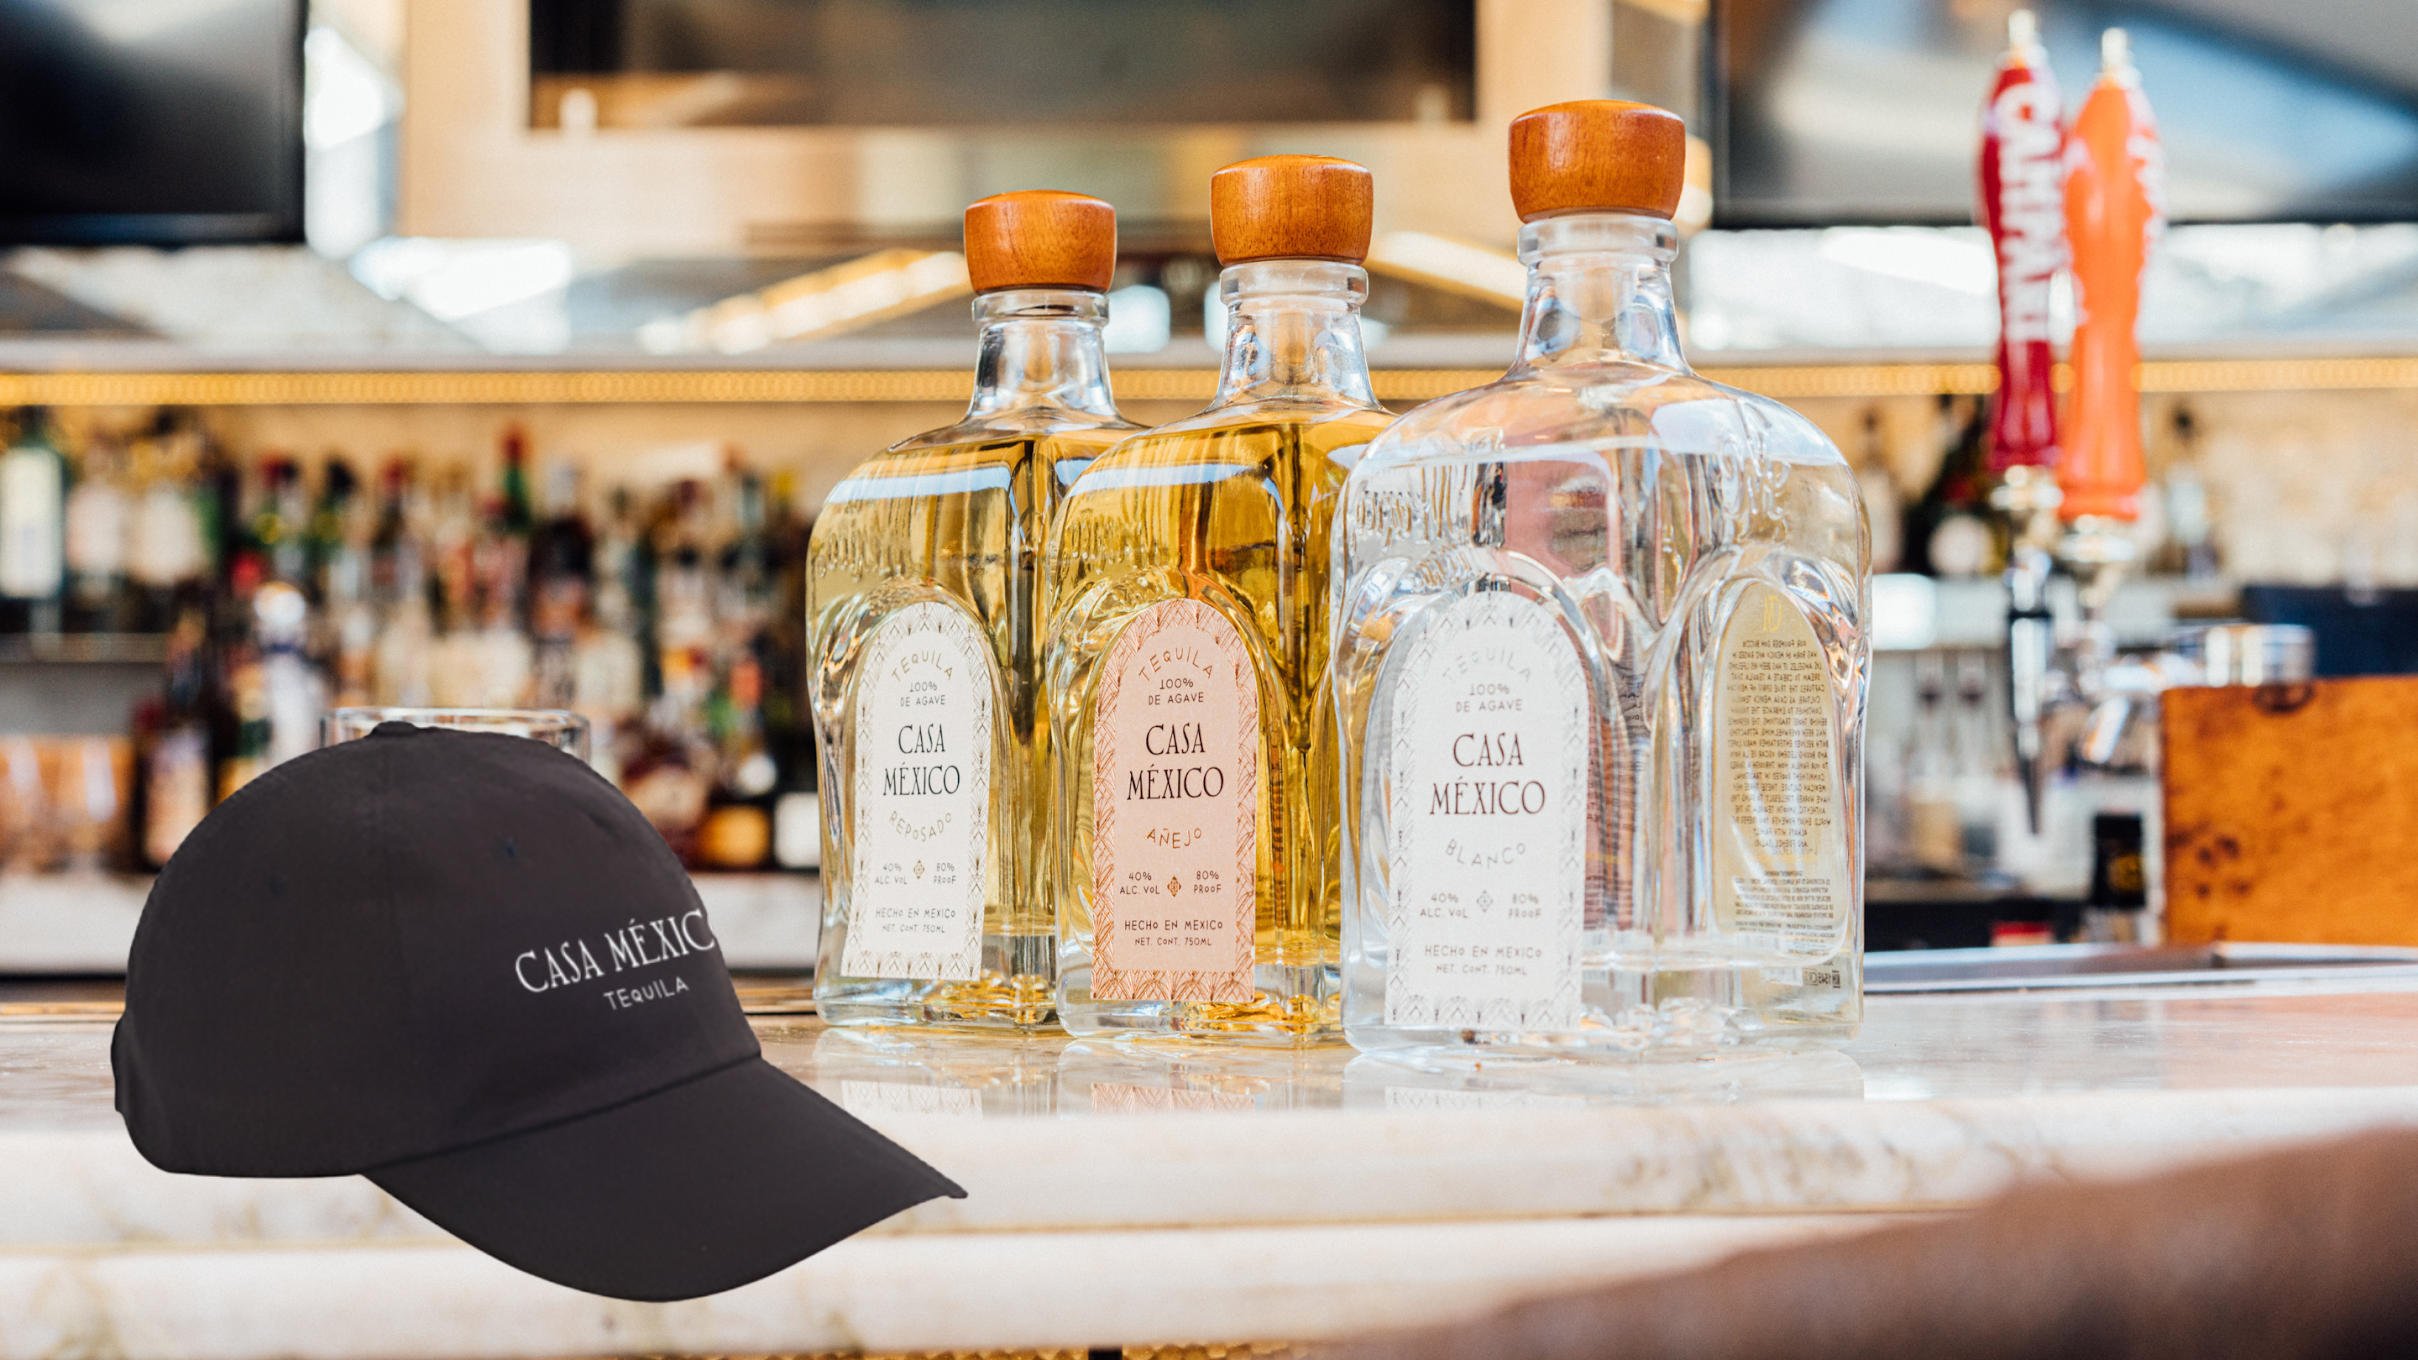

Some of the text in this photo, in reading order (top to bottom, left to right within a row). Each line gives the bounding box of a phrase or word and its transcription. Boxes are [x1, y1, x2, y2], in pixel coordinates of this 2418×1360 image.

[892, 650, 953, 682] TEQUILA
[1138, 646, 1213, 682] TEQUILA
[1442, 647, 1531, 683] TEQUILA
[909, 681, 938, 693] 100%
[1159, 677, 1194, 690] 100%
[1469, 683, 1511, 696] 100%
[900, 694, 946, 707] DE AGAVE
[1148, 691, 1204, 706] DE AGAVE
[1455, 698, 1522, 713] DE AGAVE
[898, 723, 946, 754] CASA
[1145, 722, 1206, 756] CASA
[1453, 732, 1524, 767] CASA
[883, 761, 961, 796] MÉXICO
[1126, 763, 1224, 800] MÉXICO
[1429, 775, 1546, 815] MÉXICO
[889, 810, 952, 842] REPOSADO
[1145, 827, 1202, 849] AÑEJO
[1445, 838, 1526, 869] BLANCO
[882, 862, 902, 873] 40%
[936, 862, 955, 873] 80%
[933, 875, 957, 885] PROOF
[1128, 871, 1152, 881] 40%
[1196, 870, 1220, 881] 80%
[1193, 883, 1222, 894] PROOF
[1430, 893, 1459, 904] 40%
[875, 907, 956, 919] HECHO EN MEXICO
[1508, 908, 1542, 919] PROOF
[1124, 920, 1223, 931] HECHO EN MEXICO
[514, 908, 716, 993] CASA MÉXIC
[1424, 945, 1542, 959] HECHO EN MEXICO
[603, 975, 690, 1011] TEQUILA
